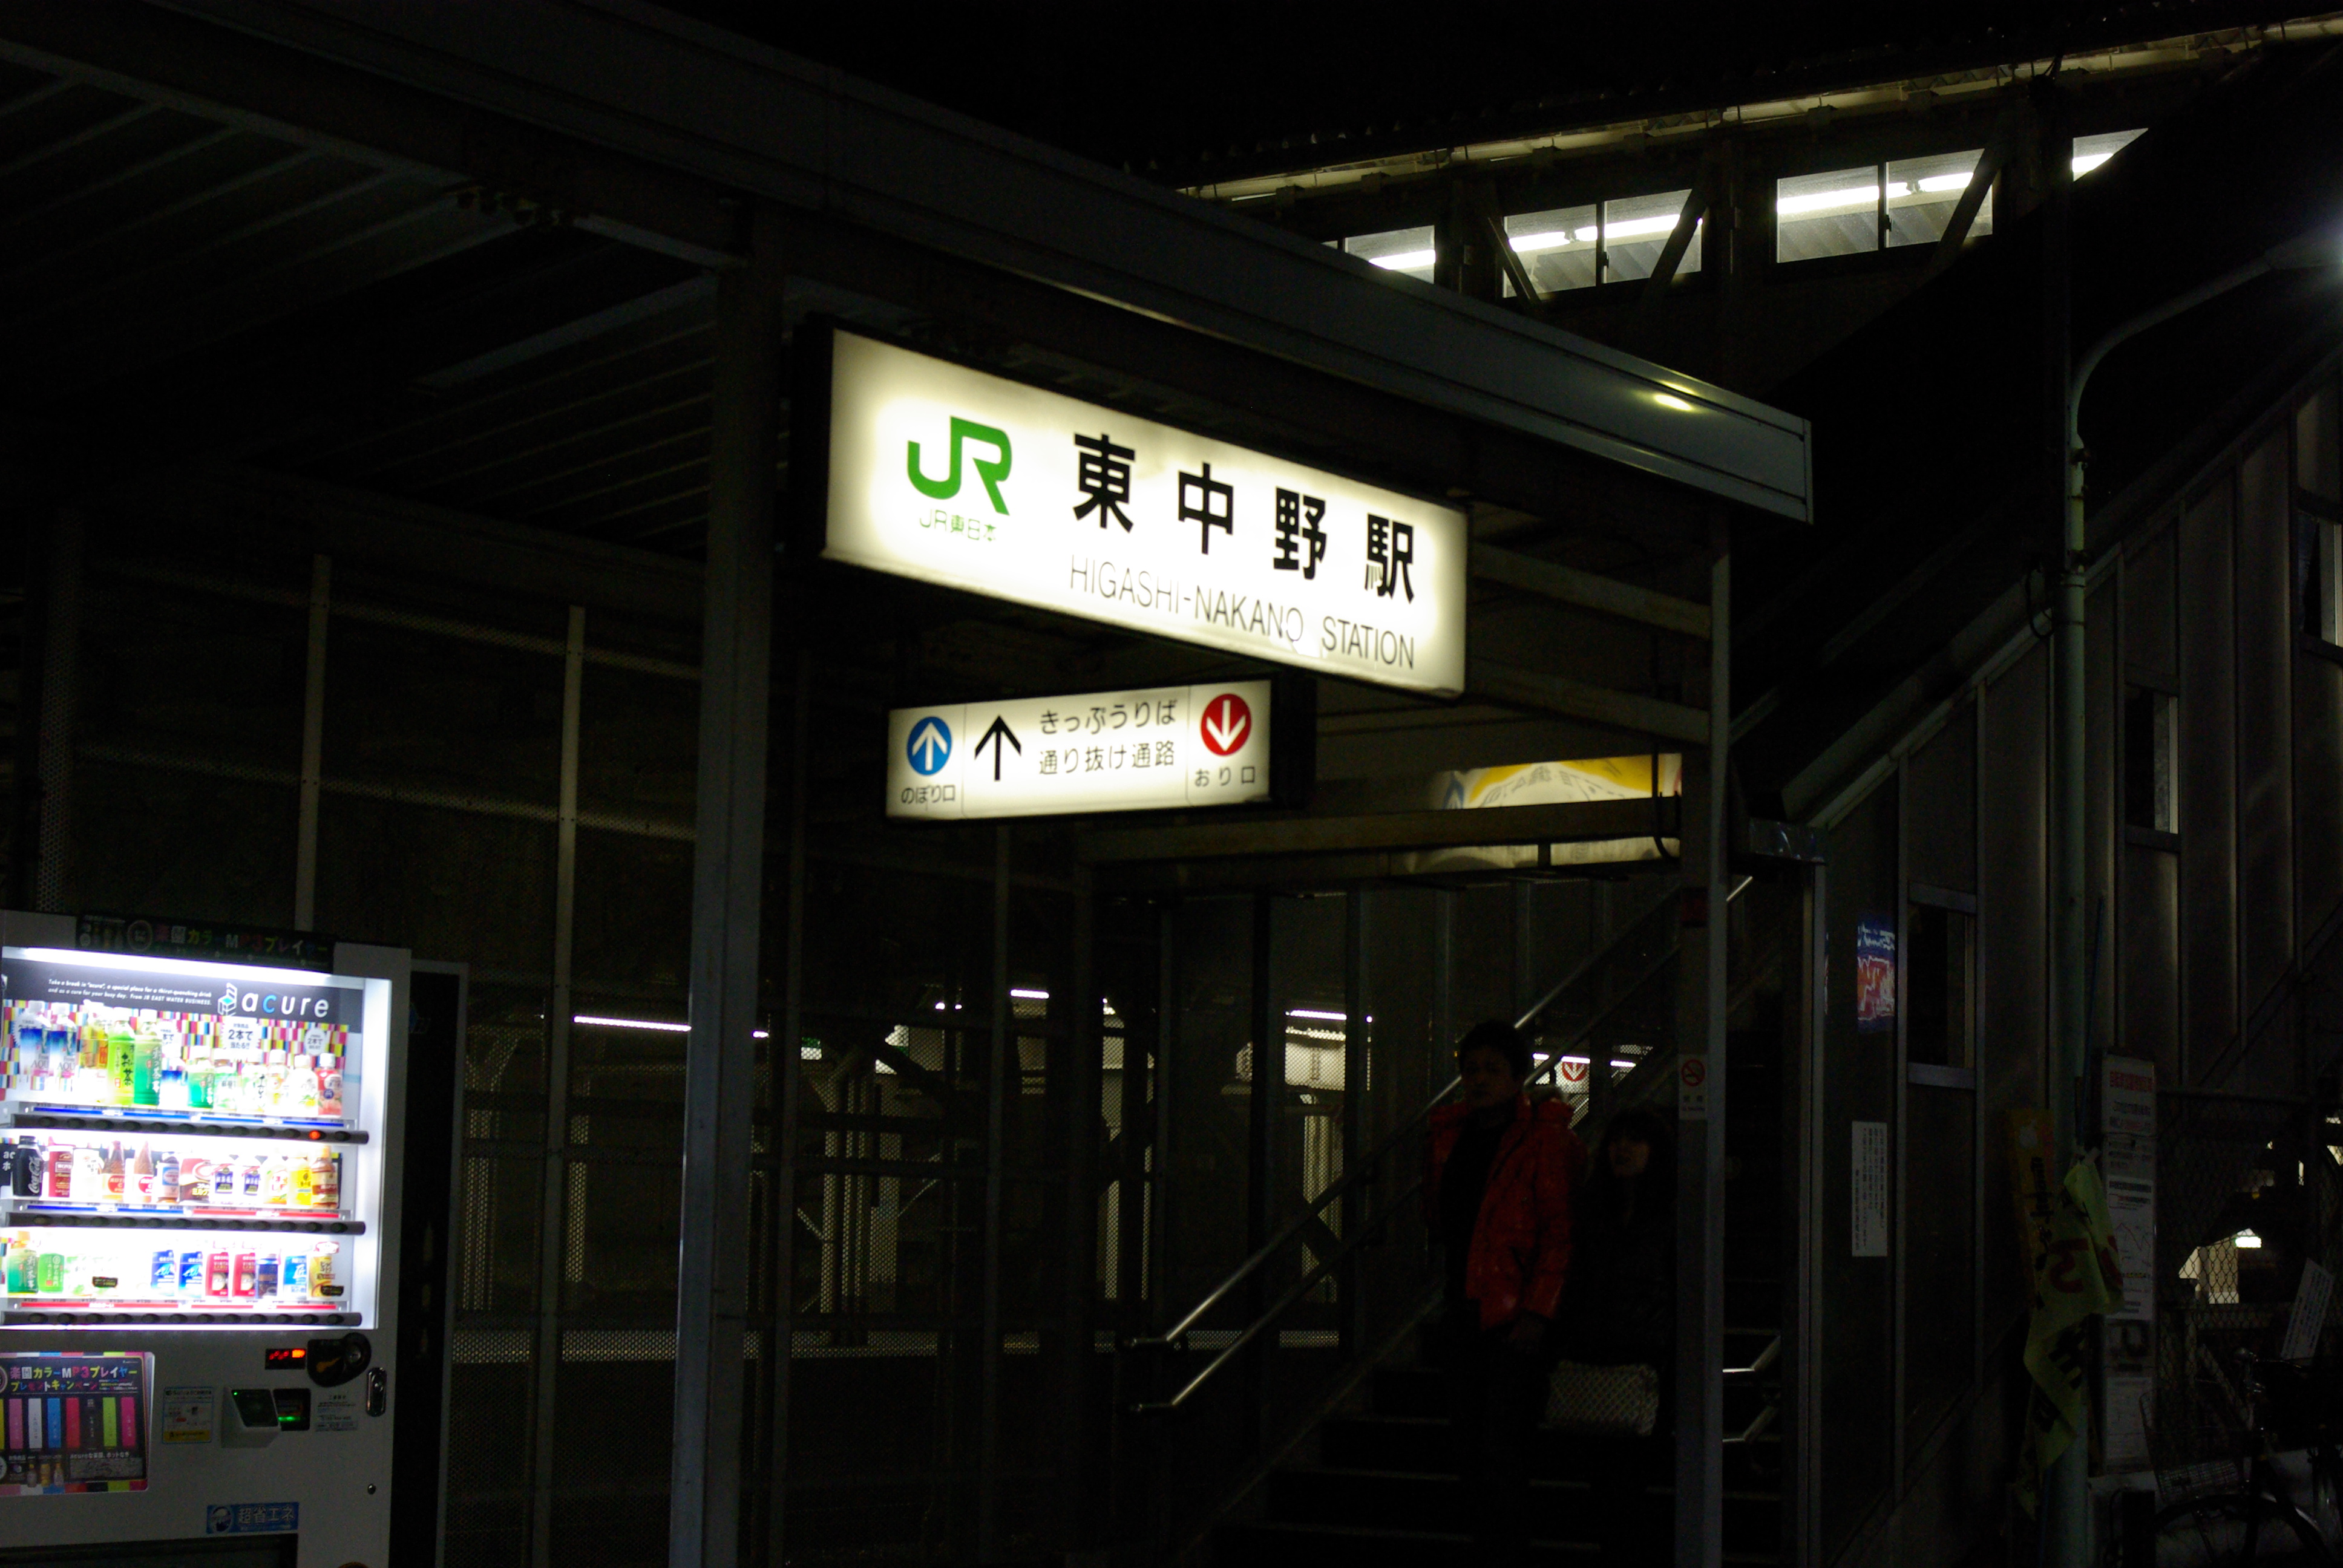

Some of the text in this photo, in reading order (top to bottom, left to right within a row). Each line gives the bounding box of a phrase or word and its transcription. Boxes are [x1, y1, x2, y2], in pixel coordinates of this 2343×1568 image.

[907, 414, 1012, 516] JR
[919, 508, 997, 542] JR東日本
[1073, 431, 1415, 604] 東中野駅
[1070, 554, 1415, 669] HIGASHI-NAKANO STATION
[1040, 699, 1177, 735] きっぷうりば
[1039, 740, 1175, 775] 通り抜け通路
[1195, 766, 1256, 787] おり口
[901, 785, 955, 805] のぼり口
[241, 990, 329, 1018] acure
[228, 1030, 253, 1040] 2本で
[10, 1365, 138, 1379] 楽園カラーMP3プレイヤー
[238, 1504, 295, 1524] 超省エネ
